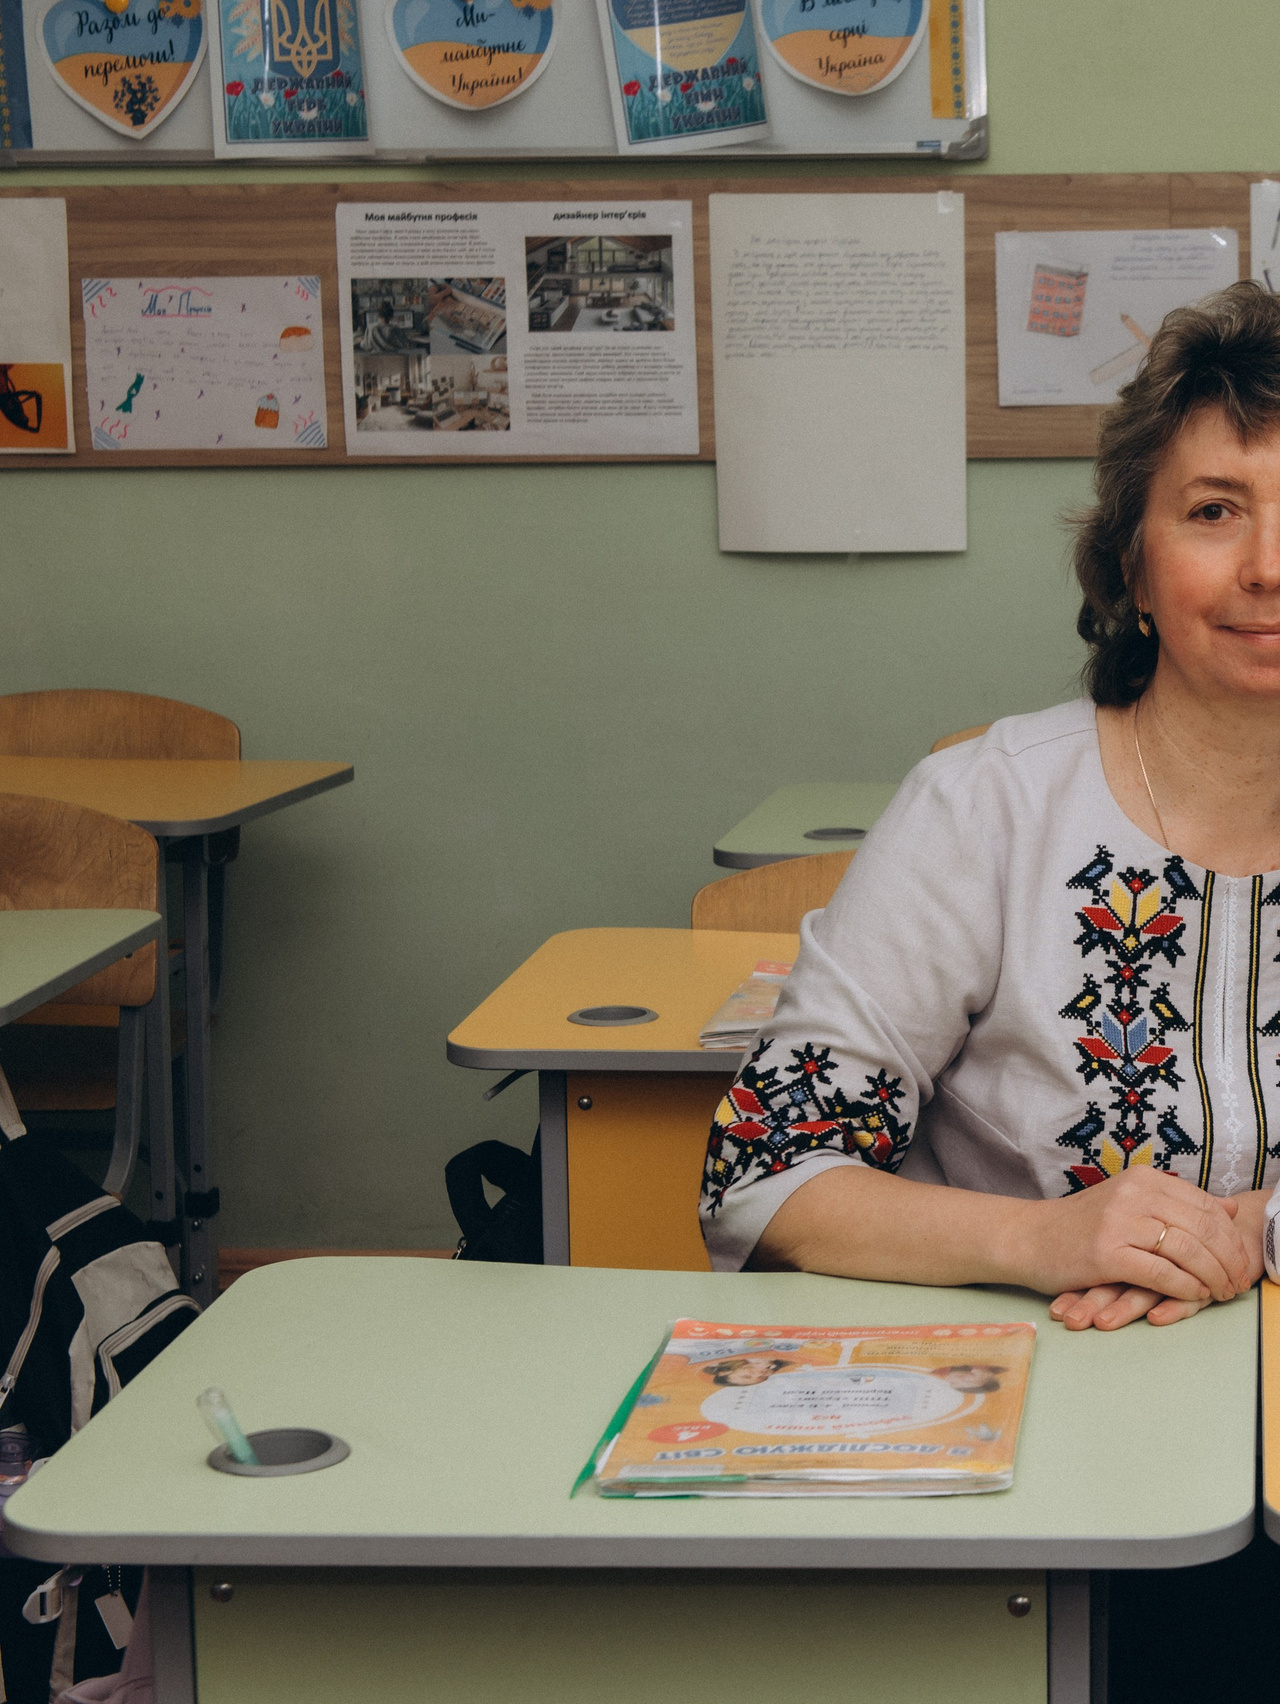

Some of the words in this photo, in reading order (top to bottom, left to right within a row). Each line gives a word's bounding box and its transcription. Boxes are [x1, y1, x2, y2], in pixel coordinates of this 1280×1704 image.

[73, 10, 140, 44] Разом
[147, 8, 168, 34] до
[829, 20, 869, 48] серці
[84, 39, 176, 87] перемоги!
[440, 39, 527, 66] майбутнє
[647, 56, 749, 92] ДЕРЖАВНИЙ
[817, 53, 886, 79] Україна
[251, 71, 353, 94] ДЕРЖАВНИЙ
[451, 67, 523, 97] України!
[287, 98, 327, 112] ГЕРБ
[684, 87, 725, 106] ГІМН
[272, 119, 343, 135] УКРАЇНИ
[671, 108, 742, 131] УКРАЇНИ
[365, 213, 386, 222] Моя
[387, 211, 433, 223] майбутня
[435, 211, 478, 222] професія
[553, 211, 599, 221] дизайнер
[677, 1430, 701, 1442] 4
[653, 1447, 727, 1462] СВІТ
[732, 1442, 945, 1456] ДОСЛІДЖУЮ
[946, 1446, 975, 1457] Я
